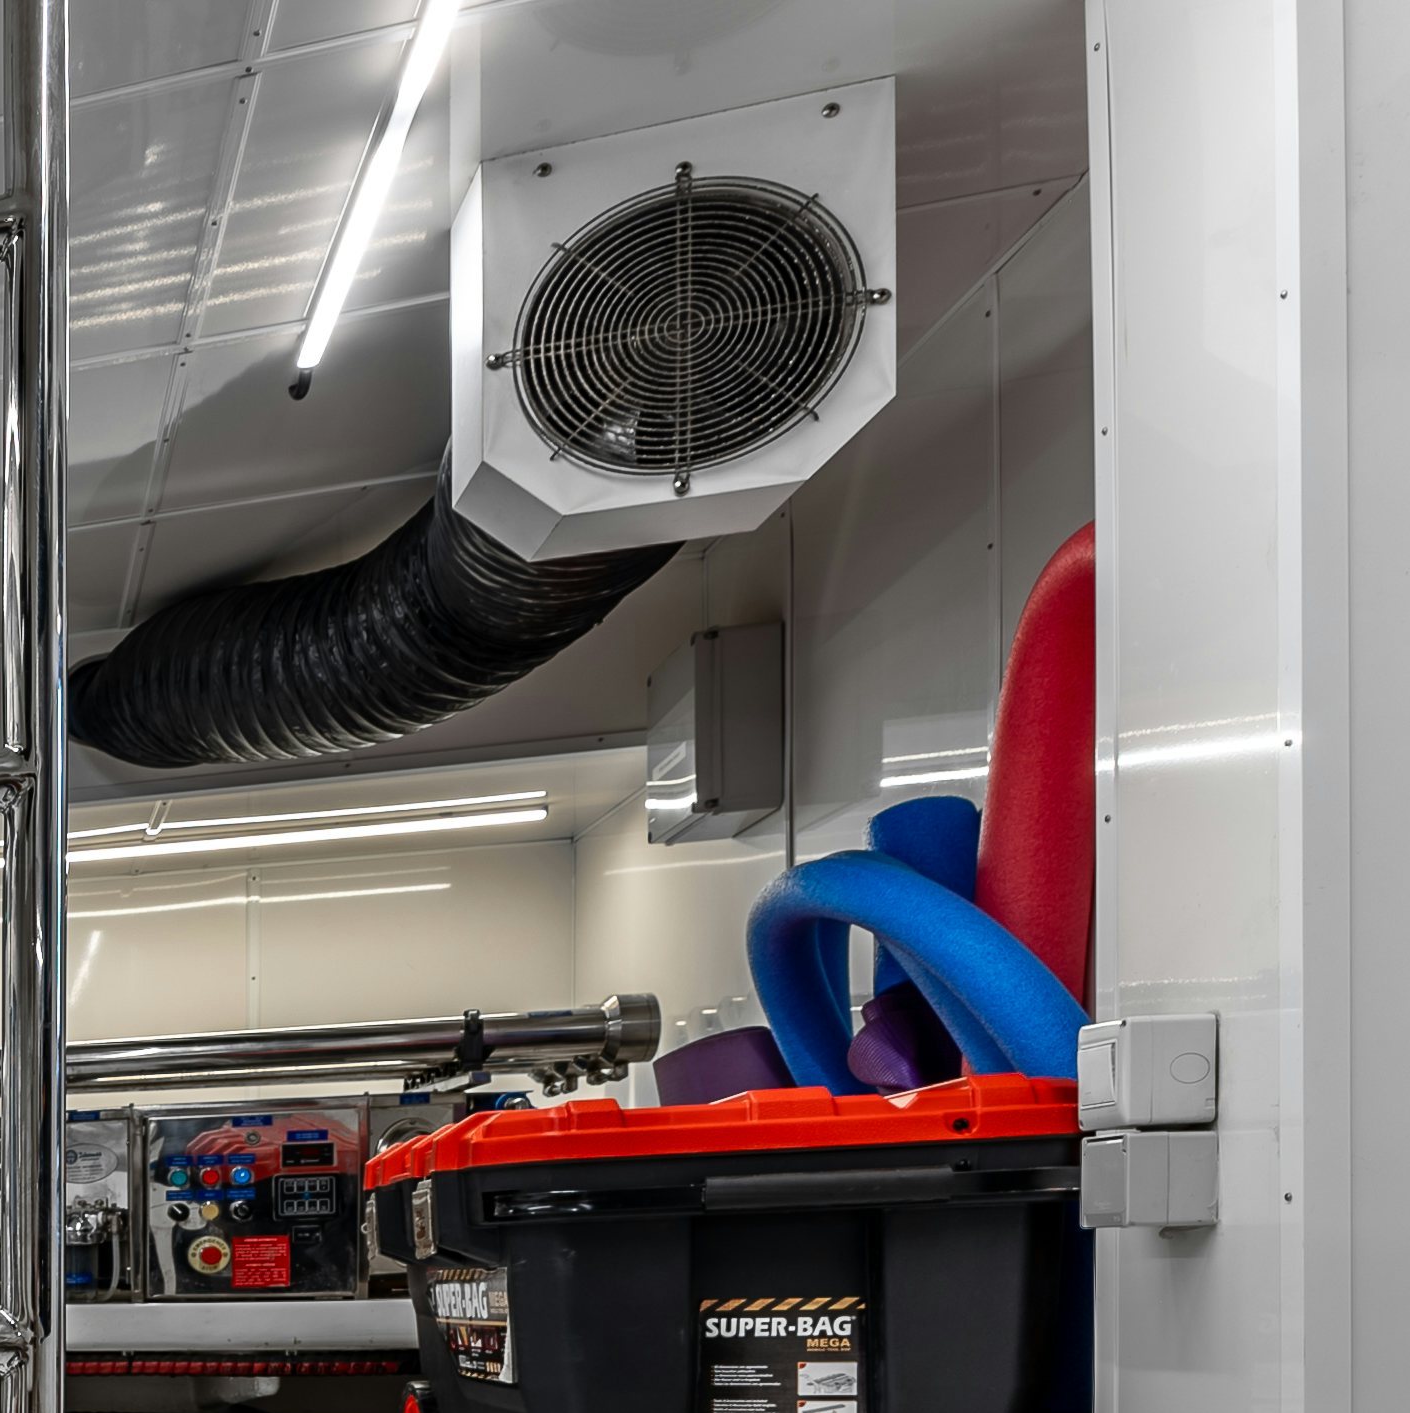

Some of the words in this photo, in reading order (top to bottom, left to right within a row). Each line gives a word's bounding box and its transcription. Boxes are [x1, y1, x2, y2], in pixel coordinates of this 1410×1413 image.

[435, 1281, 489, 1320] SUPER-BAG
[704, 1315, 853, 1338] SUPER-BAG
[806, 1338, 852, 1348] MEGA
